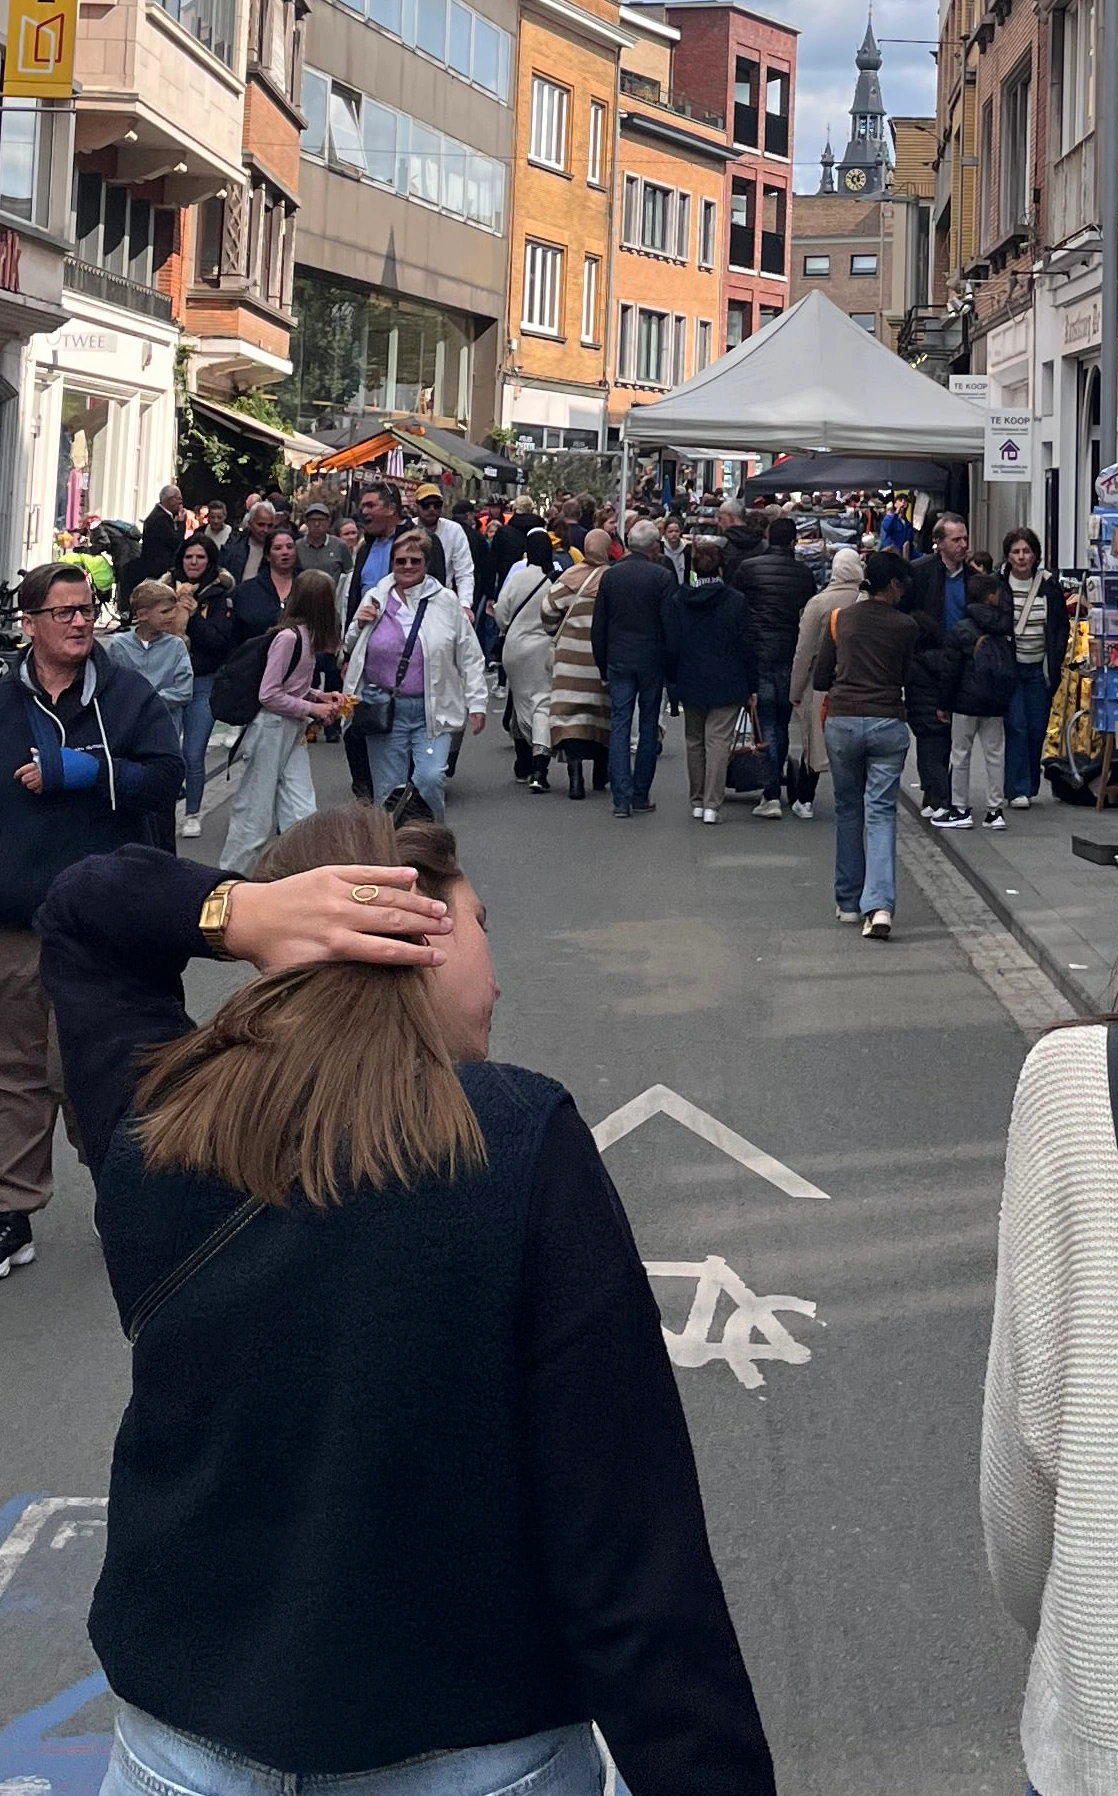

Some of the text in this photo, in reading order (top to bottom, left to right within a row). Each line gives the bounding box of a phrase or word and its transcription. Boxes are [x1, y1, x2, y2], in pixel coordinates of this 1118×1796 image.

[62, 334, 106, 348] TWEE
[990, 416, 1030, 425] TE KOOP
